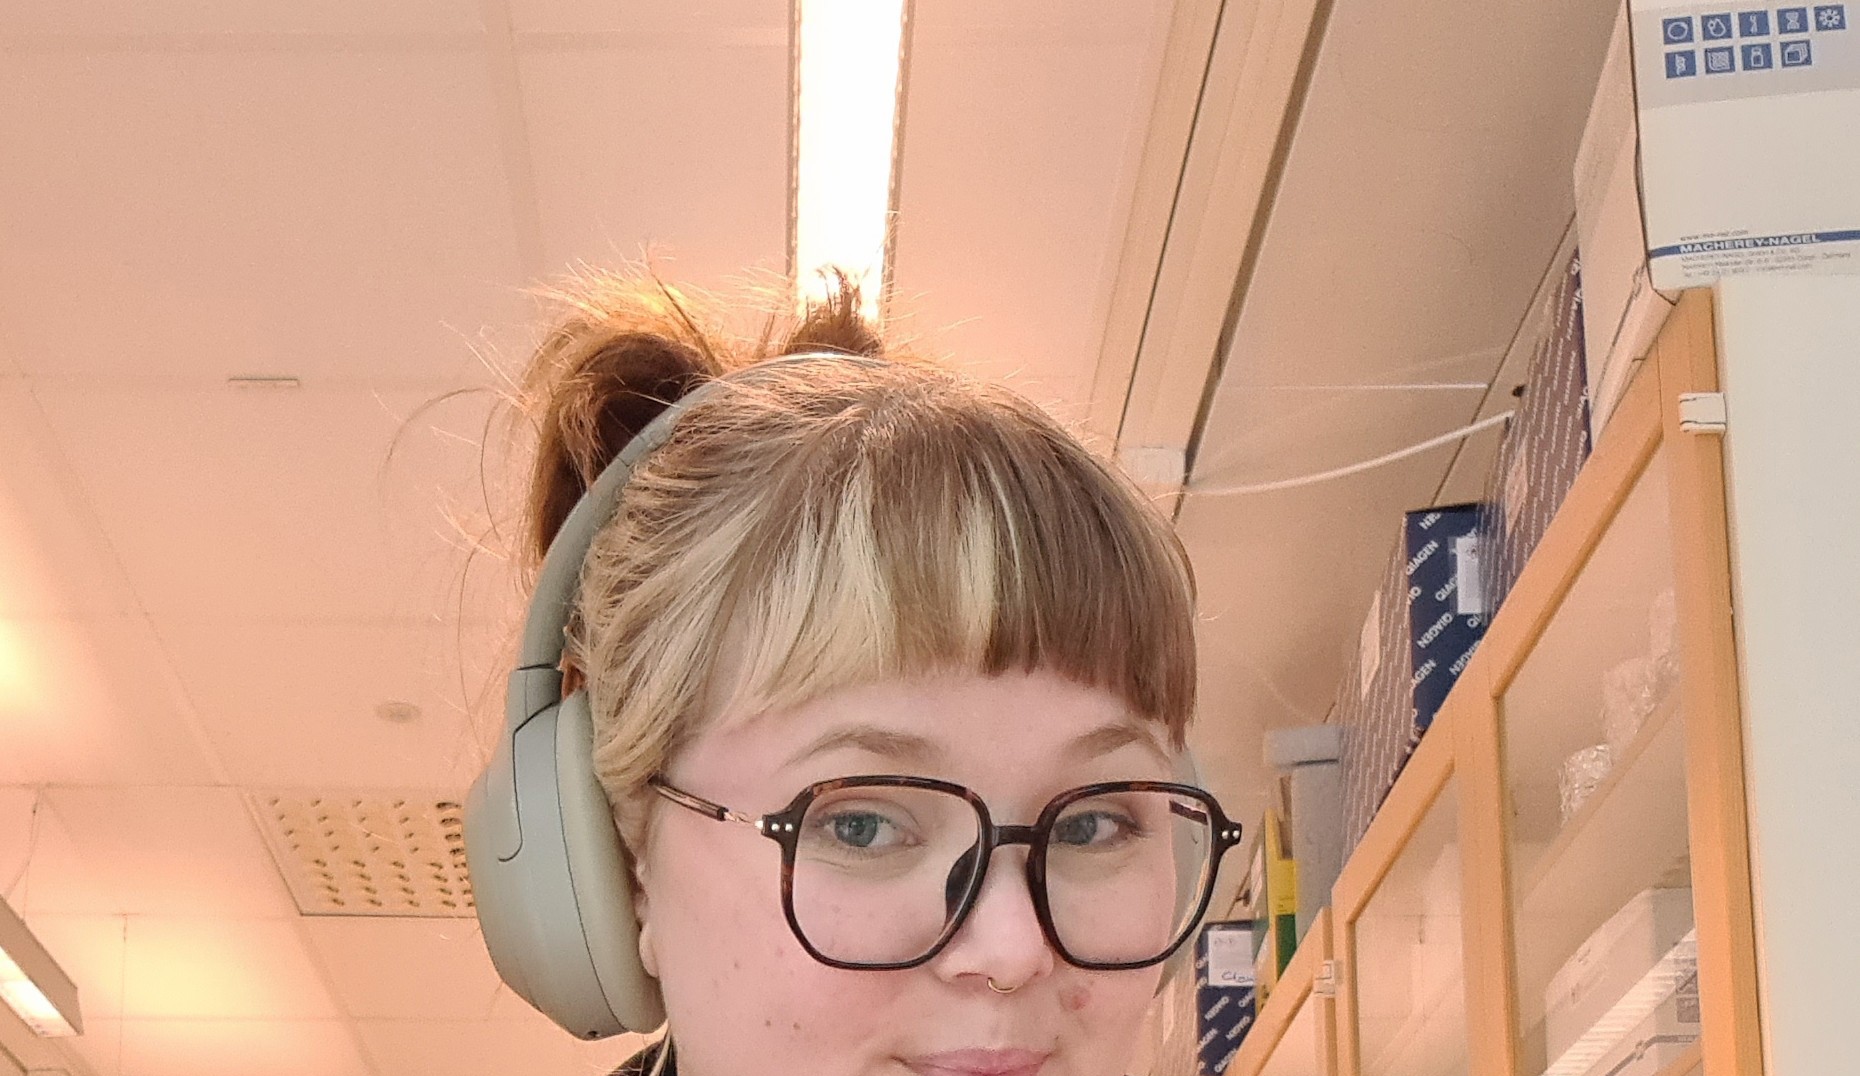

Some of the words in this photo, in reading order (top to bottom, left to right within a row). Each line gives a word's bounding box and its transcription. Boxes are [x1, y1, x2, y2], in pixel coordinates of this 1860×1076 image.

[1680, 234, 1821, 254] MACHEREY-NAGEL
[1405, 540, 1439, 576] QIAGEN
[1417, 612, 1453, 648] QIAGEN
[1204, 996, 1229, 1021] QIAGEN
